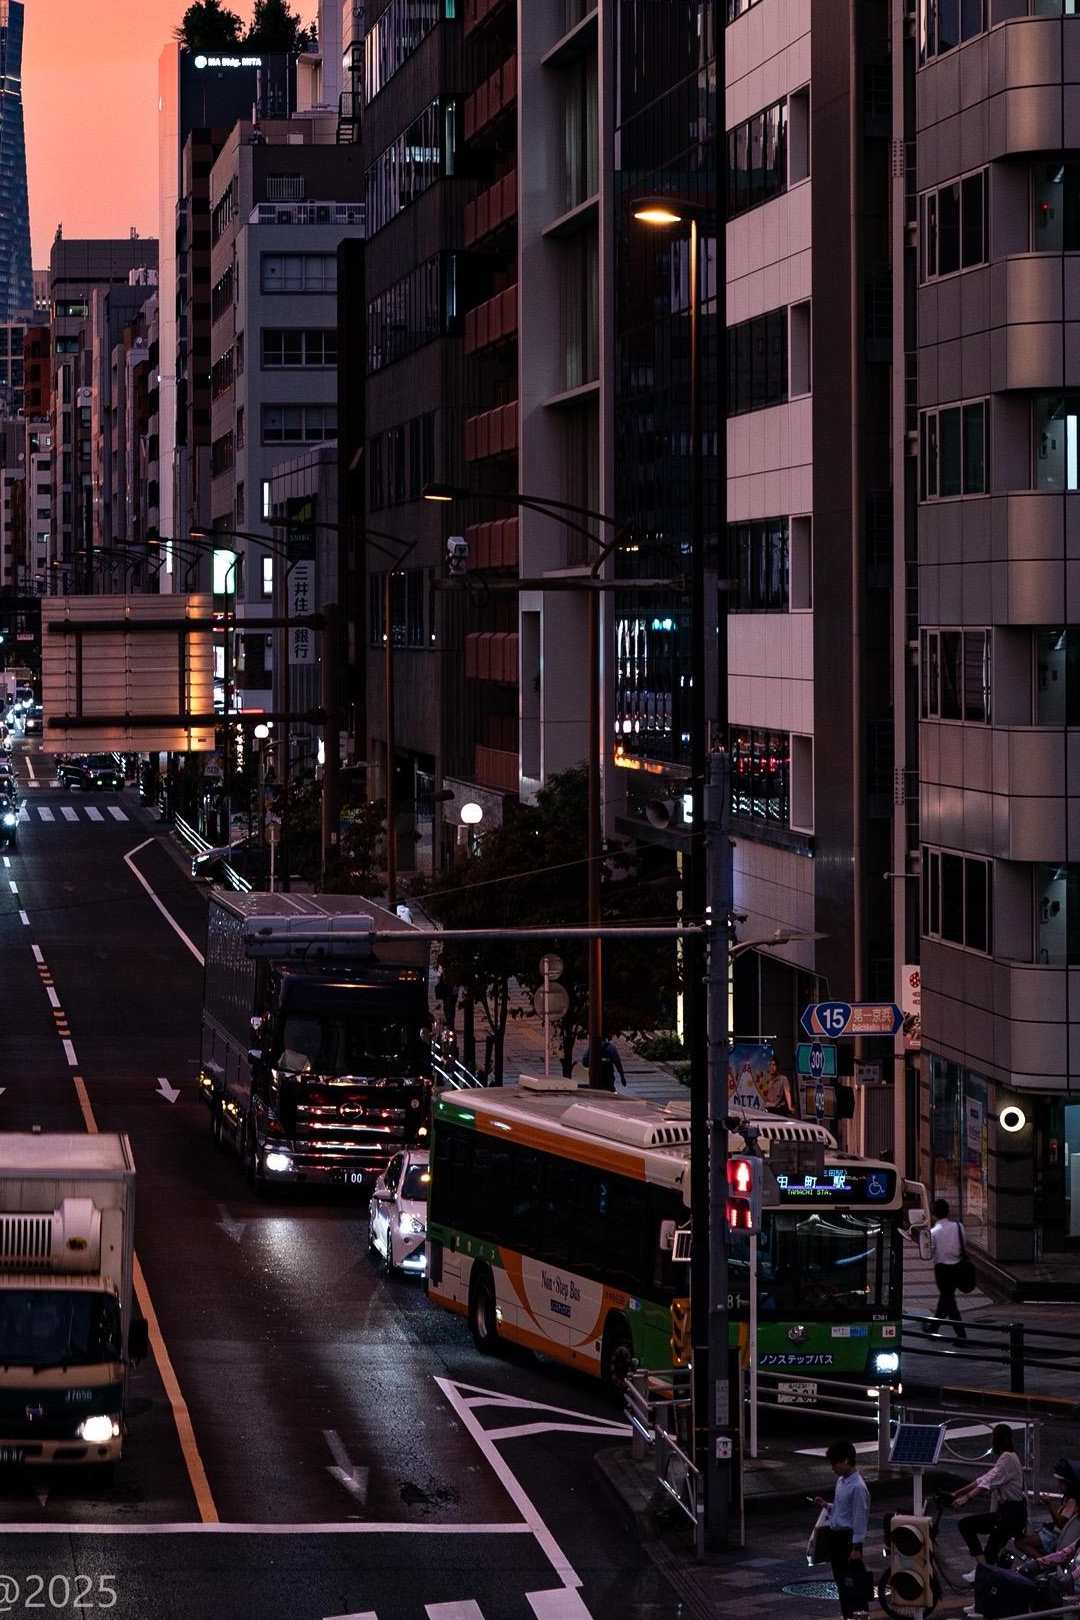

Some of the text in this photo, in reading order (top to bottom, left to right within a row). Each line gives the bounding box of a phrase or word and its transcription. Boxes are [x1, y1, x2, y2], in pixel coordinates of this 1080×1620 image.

[294, 566, 308, 658] 三井住銀行
[823, 1009, 844, 1029] 15
[854, 1009, 891, 1022] 第一京浜
[811, 1052, 823, 1069] 301
[570, 1281, 581, 1301] Bus
[760, 1354, 833, 1365] ノンステップバス
